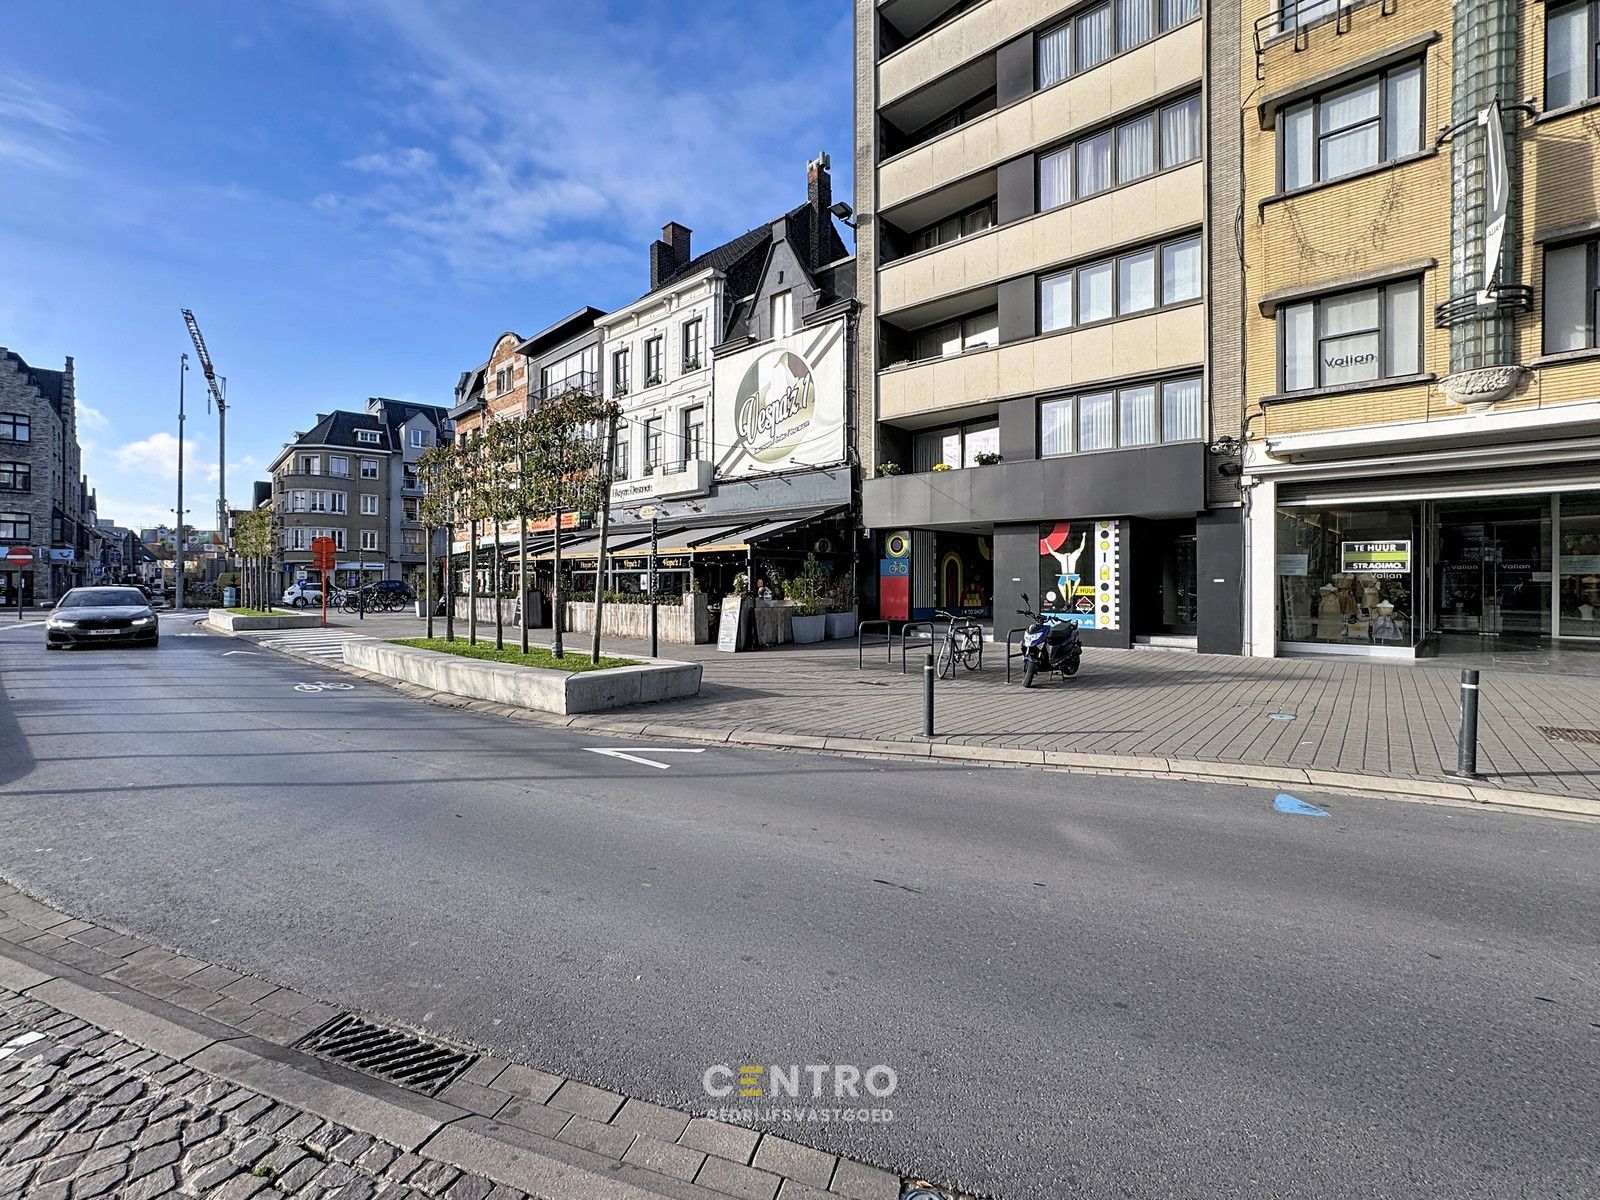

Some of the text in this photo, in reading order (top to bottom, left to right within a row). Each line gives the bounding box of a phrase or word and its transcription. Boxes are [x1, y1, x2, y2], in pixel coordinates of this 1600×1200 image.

[1324, 353, 1375, 367] Valian
[1354, 544, 1397, 552] TE HUUR
